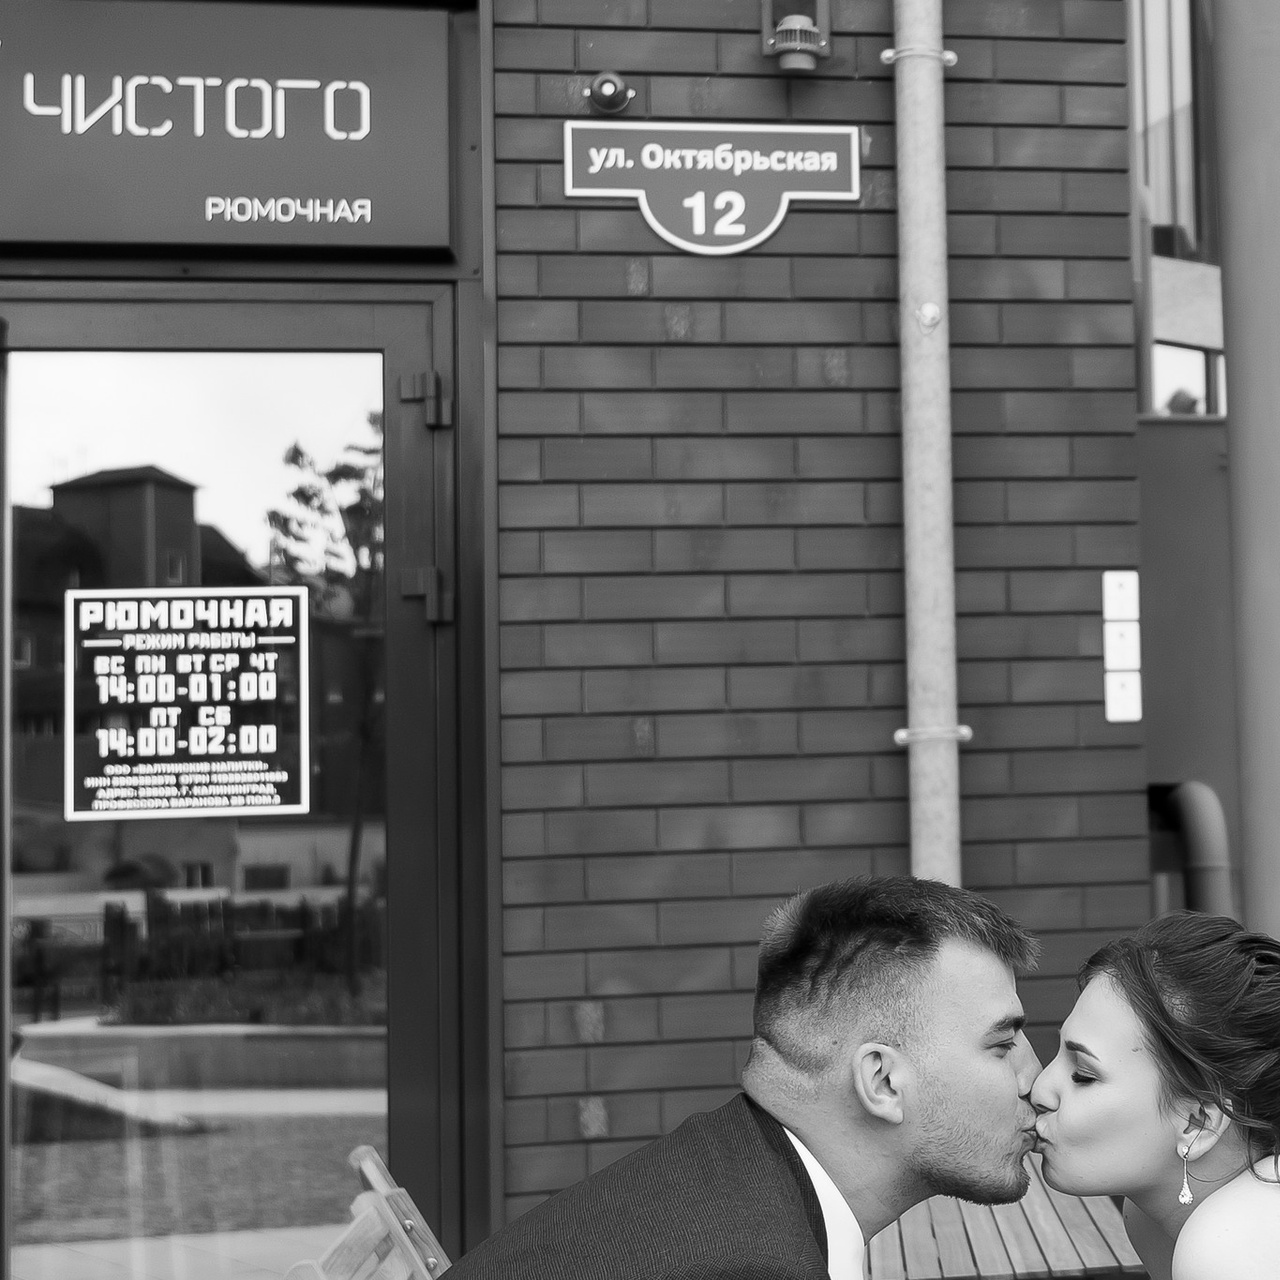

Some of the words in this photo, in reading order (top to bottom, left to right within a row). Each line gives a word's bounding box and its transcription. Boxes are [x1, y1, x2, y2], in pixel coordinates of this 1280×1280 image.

[23, 72, 371, 140] ЧИСТОГО
[588, 147, 635, 174] ул.
[641, 143, 838, 176] Октябрьская
[205, 196, 372, 223] РЮМОЧНАЯ
[682, 190, 746, 236] 12
[80, 598, 293, 631] РЮМОЧНАЯ
[122, 632, 185, 650] РЕЖИМ
[187, 631, 256, 649] РАБОТЫ
[94, 654, 125, 675] ВС
[135, 654, 166, 674] ПН
[176, 653, 206, 674] ВТ
[209, 652, 240, 673] СР
[249, 652, 279, 671] ЧТ
[96, 672, 277, 704] 14:00-01:00
[150, 706, 182, 727] ПТ
[198, 705, 231, 726] СБ
[96, 724, 277, 758] 14:00-02:00
